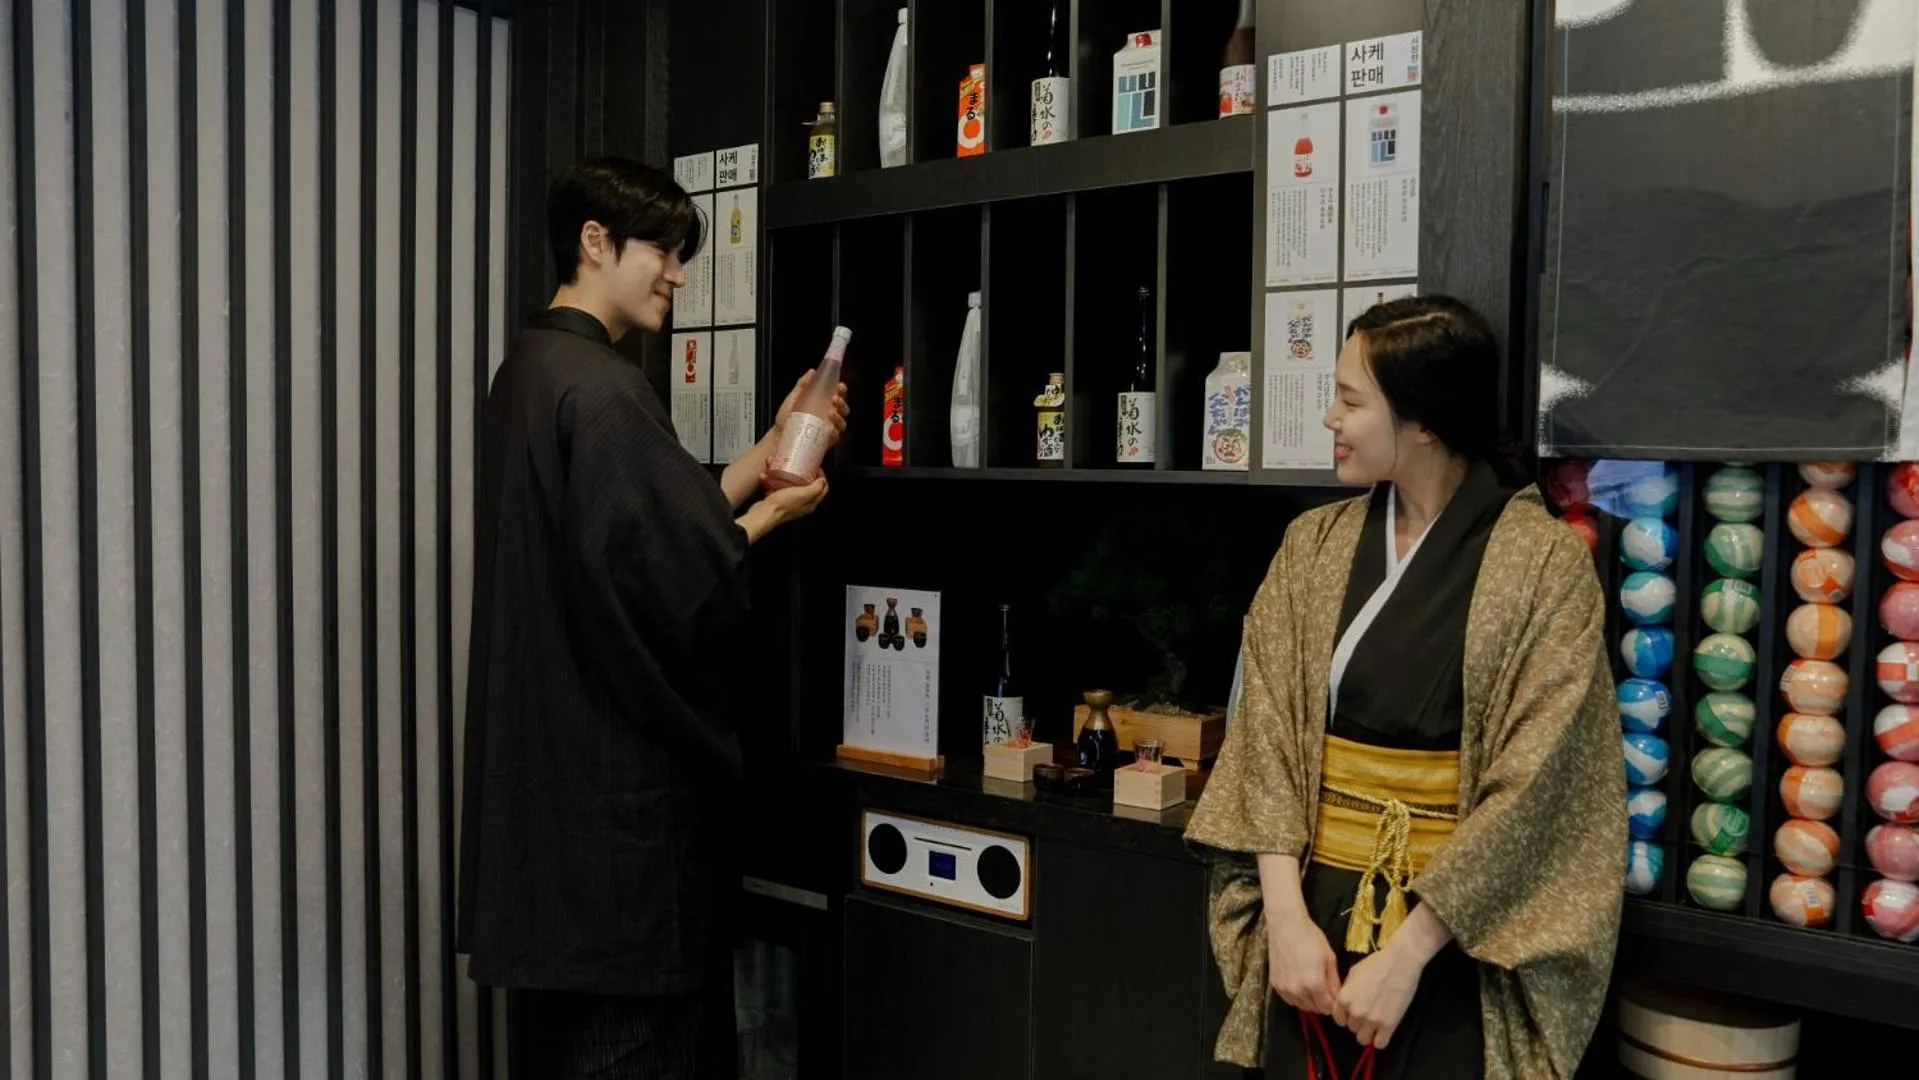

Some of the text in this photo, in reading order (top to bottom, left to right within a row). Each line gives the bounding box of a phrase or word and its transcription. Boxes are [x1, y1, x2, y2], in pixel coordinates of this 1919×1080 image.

[1351, 41, 1384, 64] 사케
[1351, 66, 1384, 88] 판매
[966, 92, 978, 120] まる
[1040, 80, 1056, 130] 菊水の
[719, 150, 738, 166] 사케
[1126, 397, 1142, 447] 菊水の
